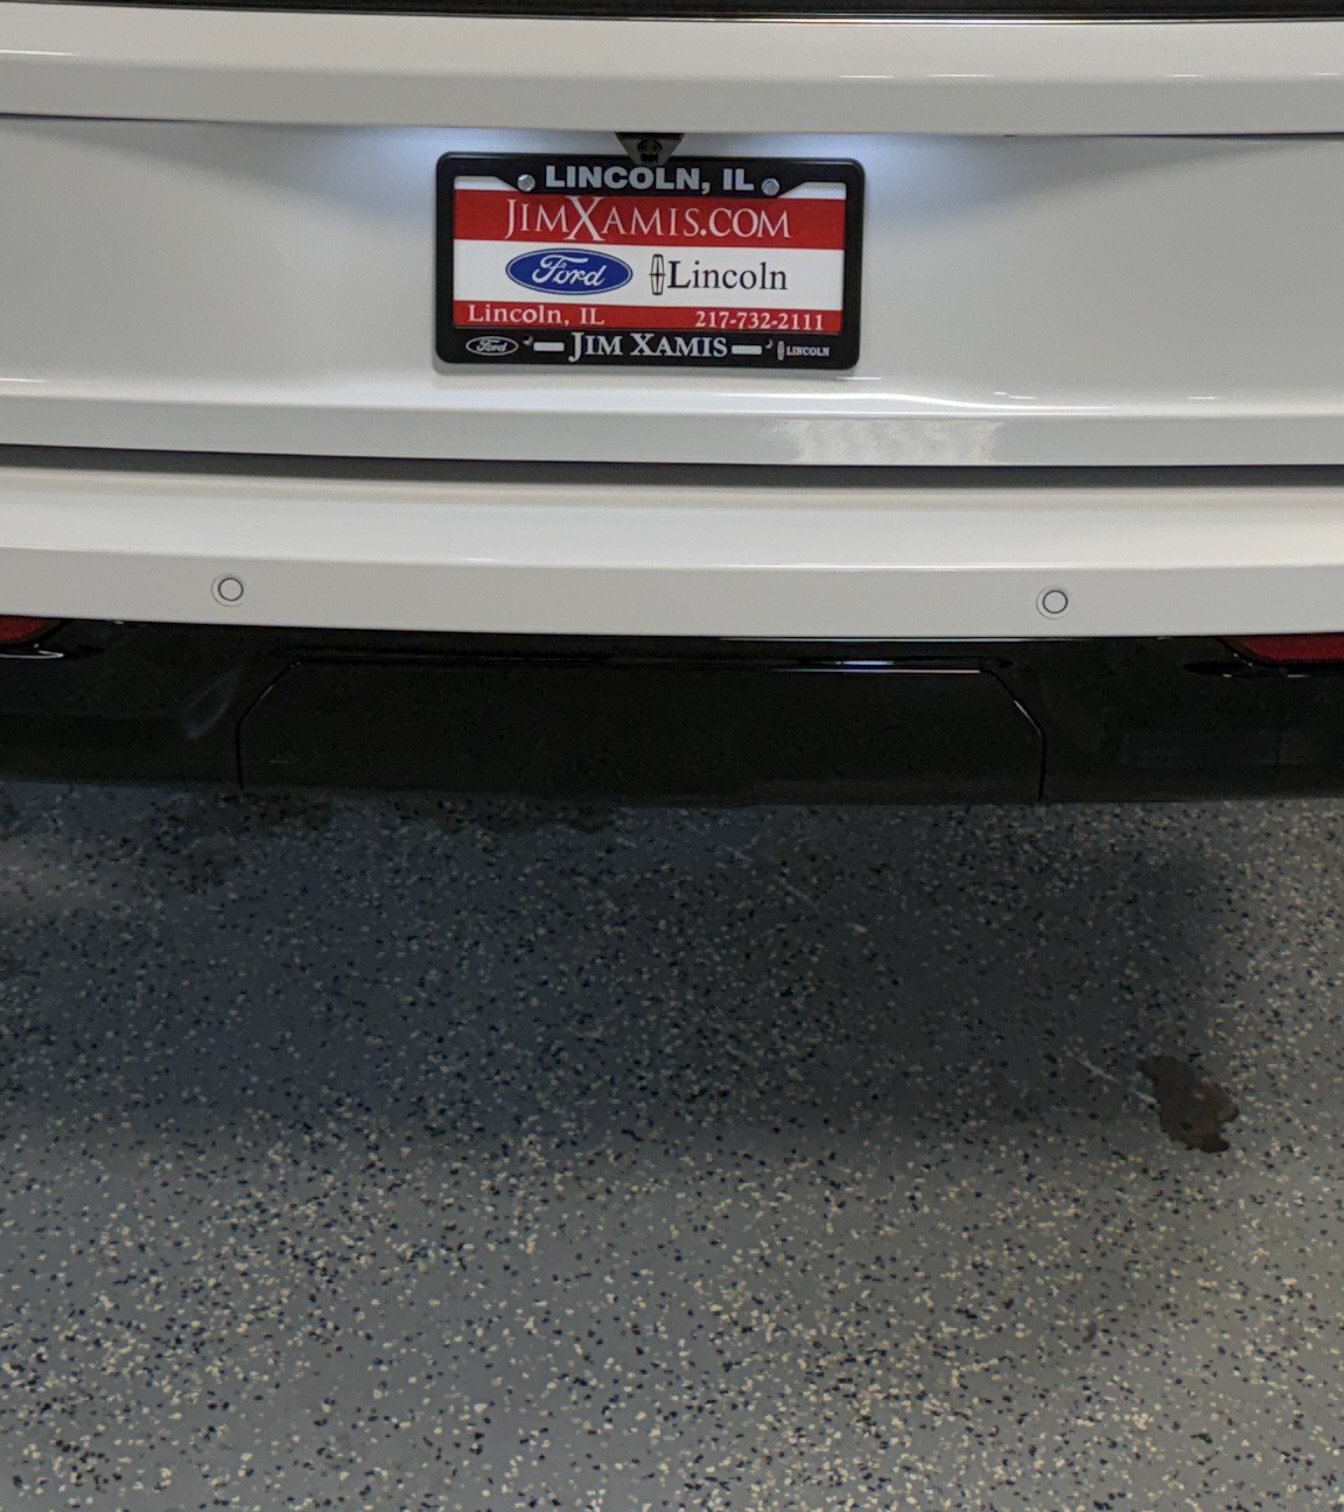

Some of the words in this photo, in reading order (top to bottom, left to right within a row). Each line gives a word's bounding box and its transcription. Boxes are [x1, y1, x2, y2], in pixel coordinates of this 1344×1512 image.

[545, 165, 711, 195] LINCOLN,
[723, 168, 755, 192] IL
[532, 254, 606, 287] Ford
[668, 260, 788, 291] Lincoln
[468, 303, 570, 328] Lincoln,
[580, 307, 605, 326] IL
[694, 310, 825, 332] 217-732-2111
[568, 331, 624, 363] JIM
[630, 332, 728, 359] XAMIS
[785, 345, 830, 358] LINCOLN
